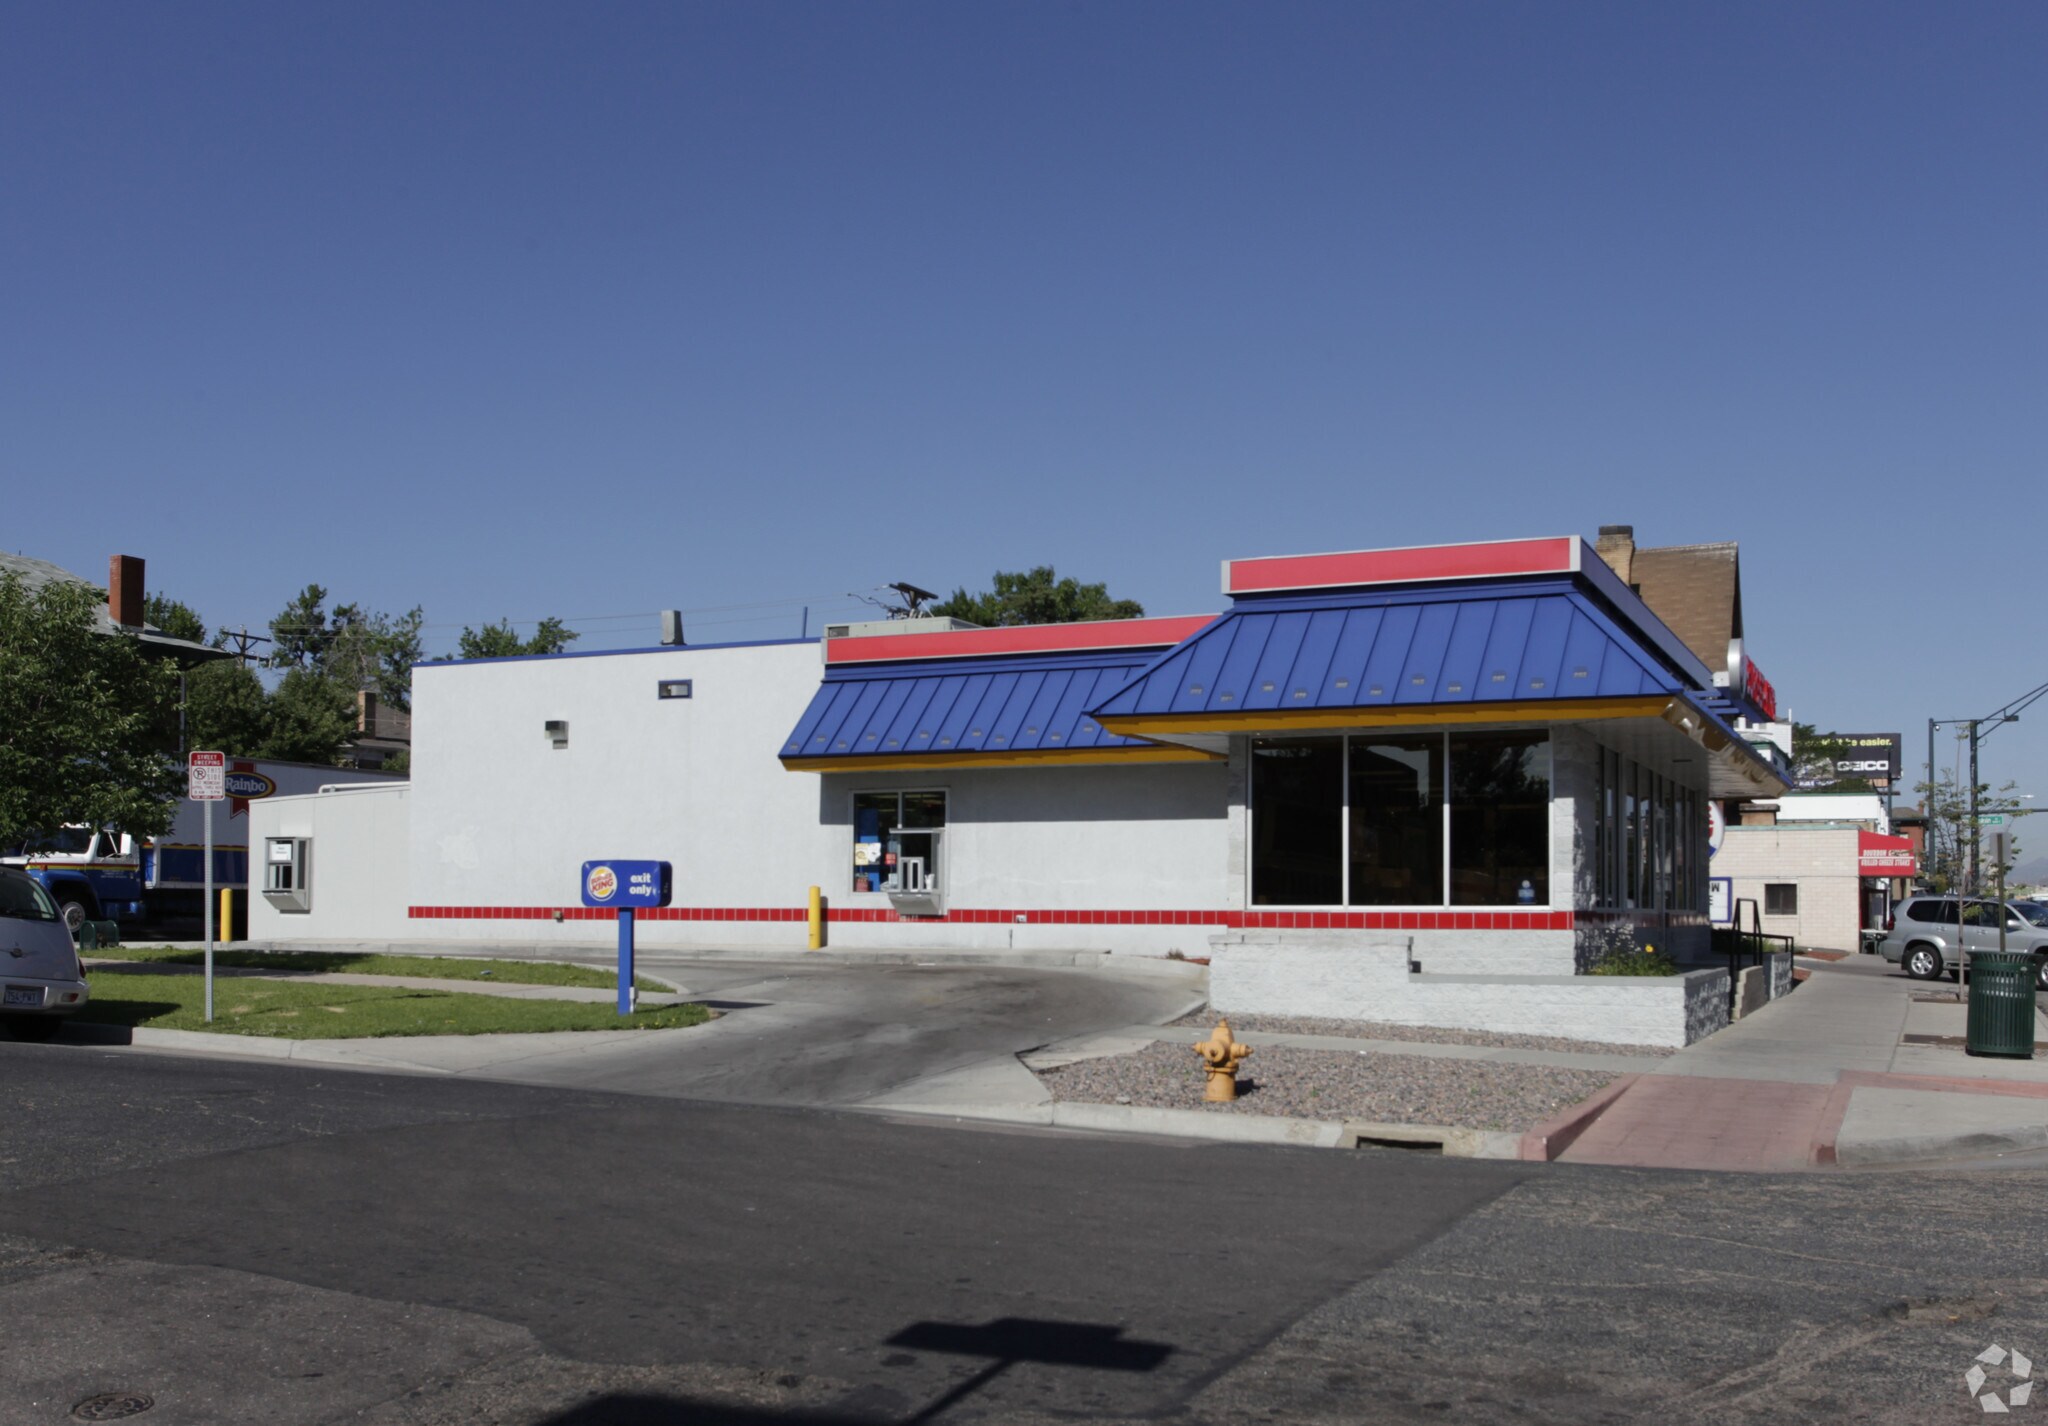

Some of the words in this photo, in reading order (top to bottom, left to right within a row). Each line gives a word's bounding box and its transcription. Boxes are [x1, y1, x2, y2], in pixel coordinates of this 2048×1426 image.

[1860, 737, 1892, 746] easier.
[1837, 760, 1889, 771] GEICO
[225, 777, 266, 793] Rainbo
[630, 872, 651, 883] exit
[591, 879, 613, 893] KING
[629, 886, 652, 896] only
